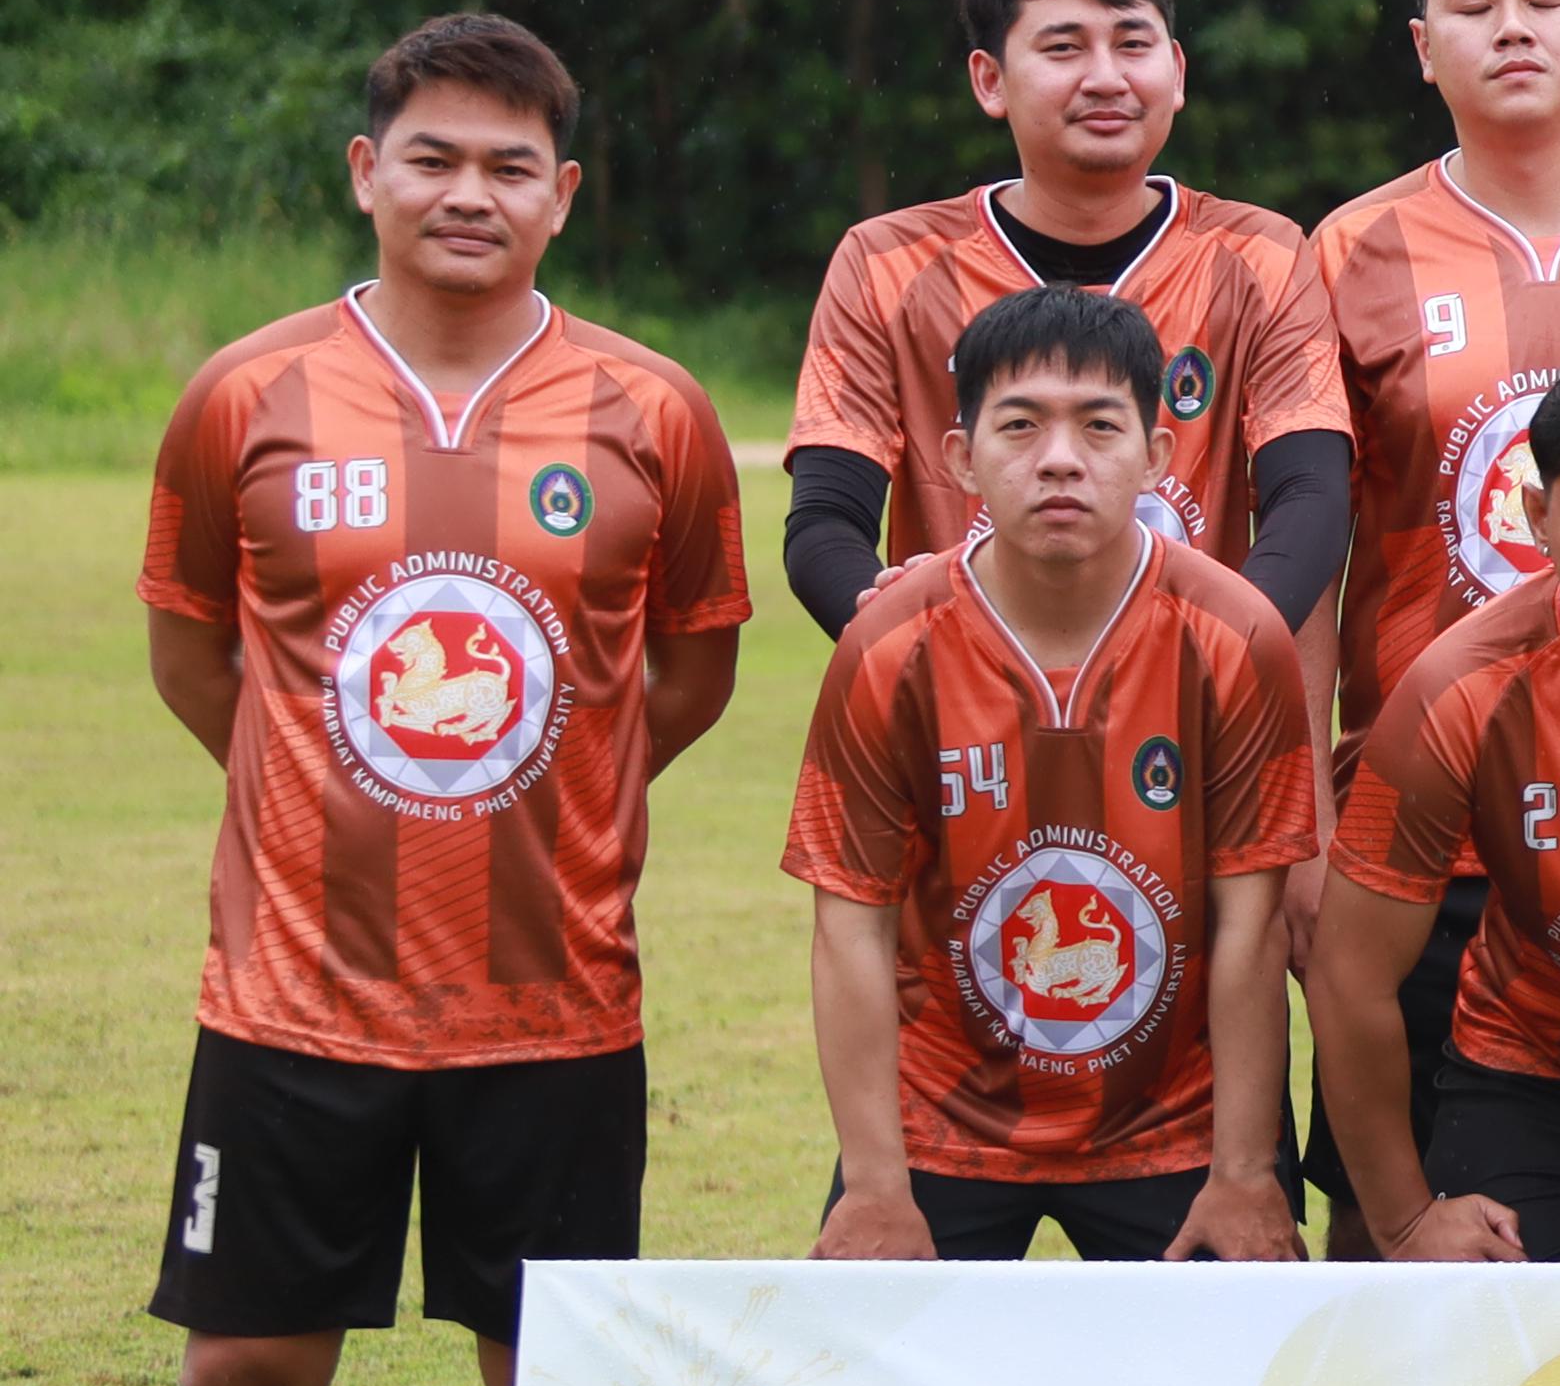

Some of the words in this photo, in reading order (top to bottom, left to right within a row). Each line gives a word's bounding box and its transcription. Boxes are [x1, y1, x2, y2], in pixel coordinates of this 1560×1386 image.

[1423, 292, 1468, 358] 9
[1440, 393, 1494, 475] PUBLIC
[296, 457, 389, 532] 88
[324, 573, 386, 653] PUBLIC
[390, 550, 570, 655] ADMINISTRATION
[352, 767, 462, 822] KAMPHAENG
[475, 788, 520, 817] PHET
[516, 683, 576, 792] UNIVERSITY
[938, 742, 1008, 817] 54
[953, 853, 1012, 920] PUBLIC
[1016, 824, 1182, 921] ADMINISTRATION
[1087, 1042, 1133, 1073] PHET
[1135, 943, 1187, 1044] UNIVERSITY
